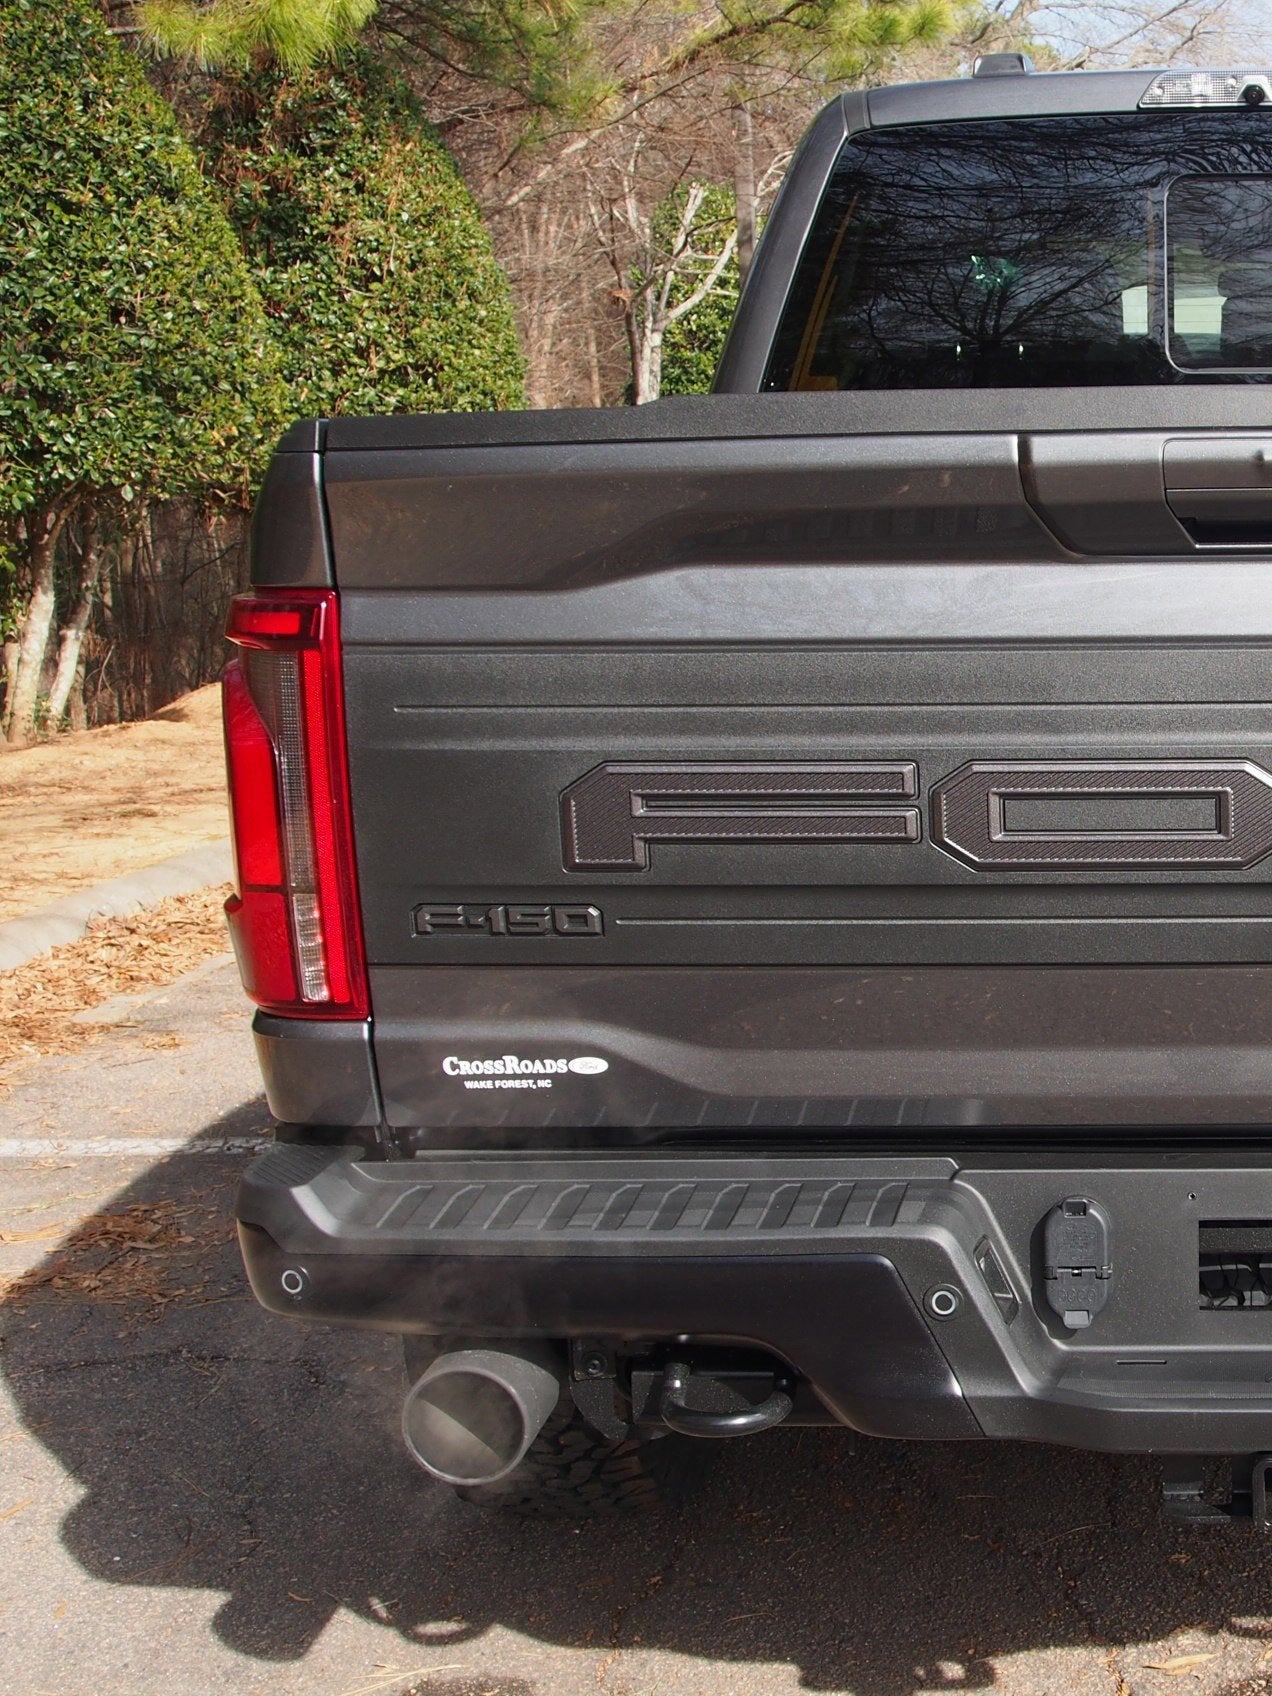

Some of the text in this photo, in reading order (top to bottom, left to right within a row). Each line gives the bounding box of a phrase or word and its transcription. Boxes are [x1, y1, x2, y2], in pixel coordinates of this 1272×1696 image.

[411, 903, 604, 936] F-150
[464, 1080, 552, 1089] WAKE FOREST, NC
